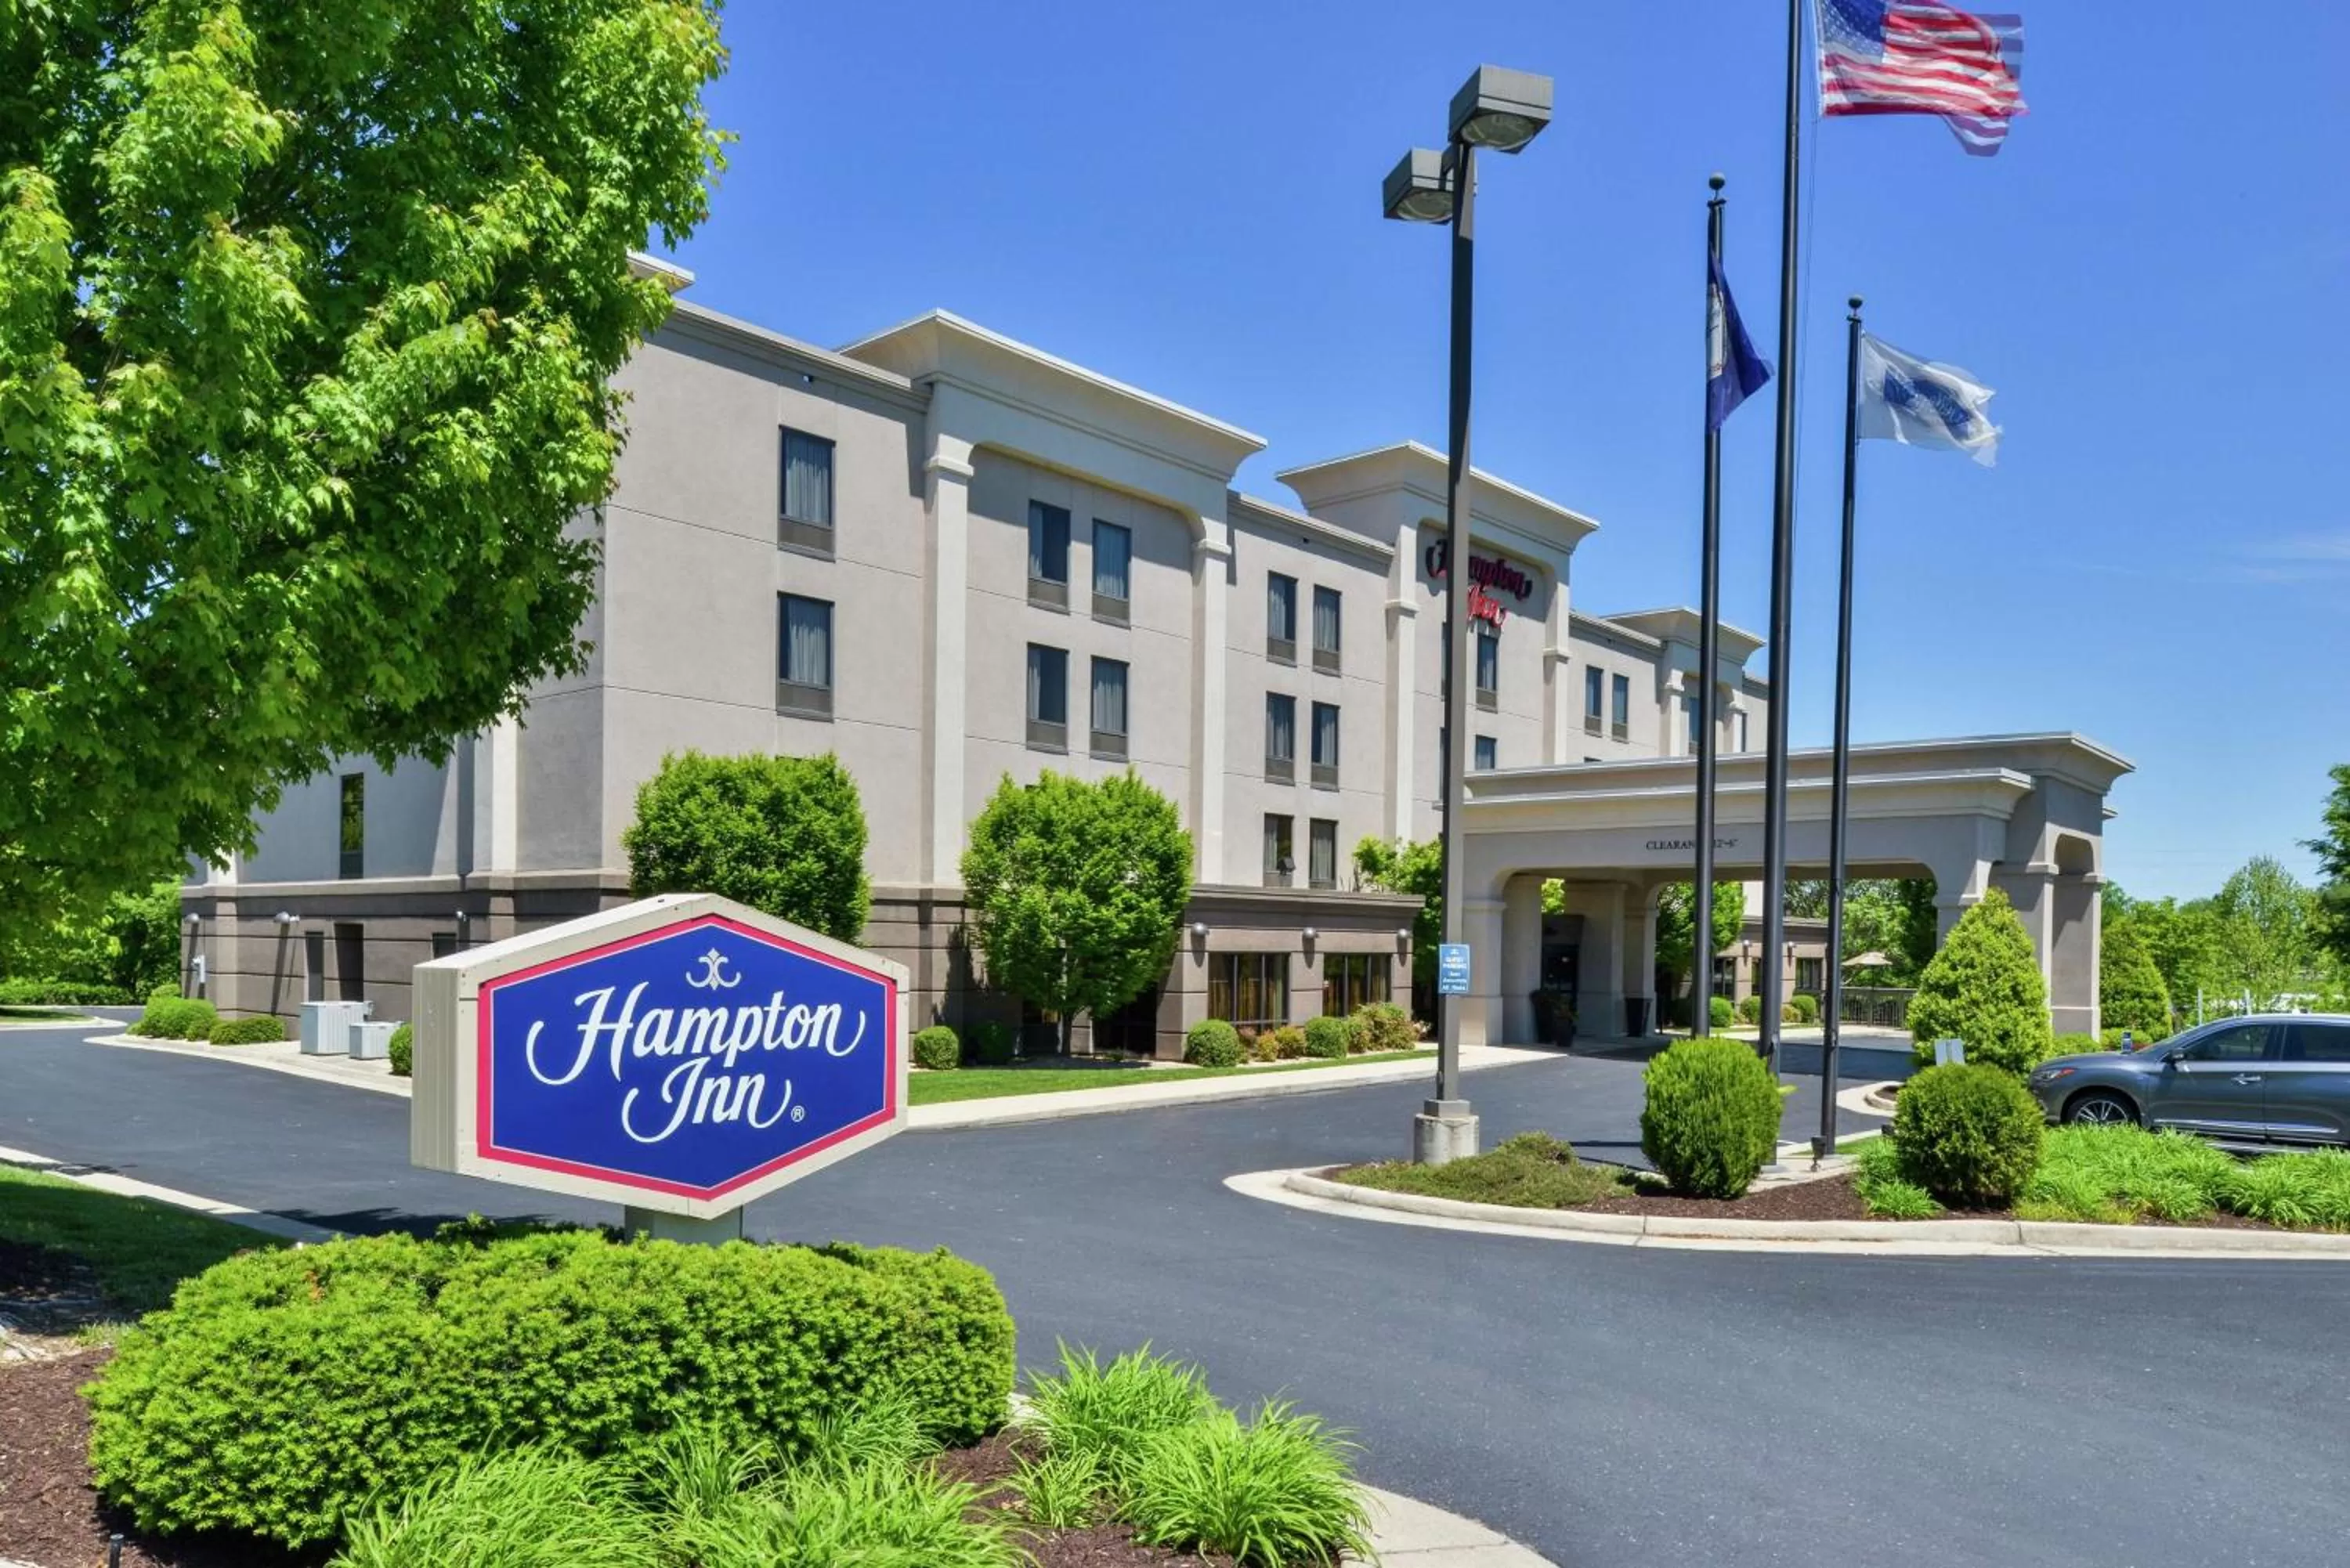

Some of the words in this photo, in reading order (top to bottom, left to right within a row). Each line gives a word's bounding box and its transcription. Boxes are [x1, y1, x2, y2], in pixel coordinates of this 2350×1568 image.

[1646, 840, 1697, 850] CLEARAN
[526, 981, 866, 1086] Hampton
[621, 1056, 792, 1143] Inn
